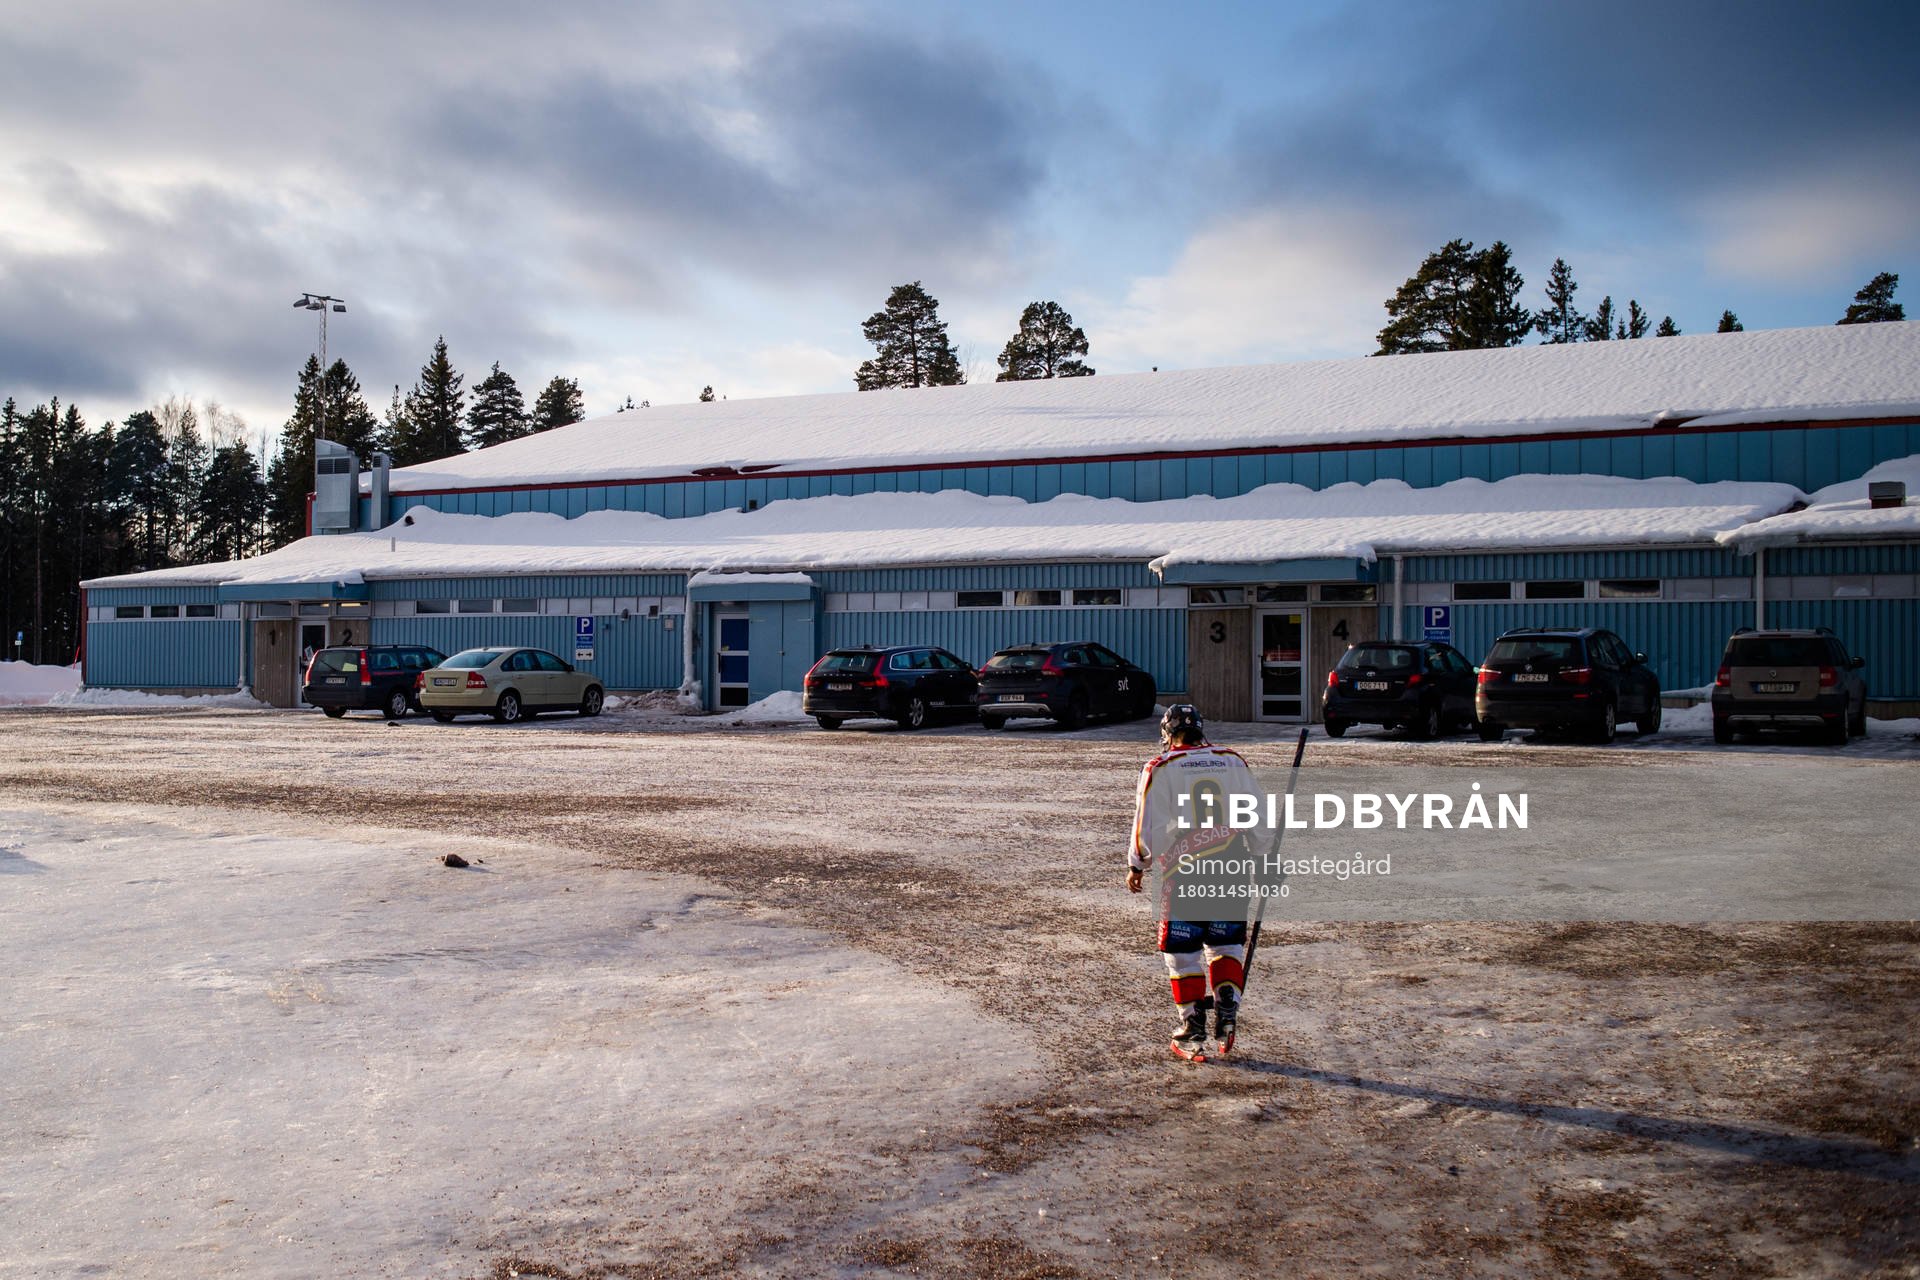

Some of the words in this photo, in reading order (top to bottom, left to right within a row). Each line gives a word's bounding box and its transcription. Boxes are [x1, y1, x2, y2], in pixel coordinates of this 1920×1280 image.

[581, 618, 590, 633] P
[1431, 608, 1445, 627] P
[269, 629, 276, 646] 1
[342, 629, 353, 645] 2
[1210, 621, 1226, 644] 3
[1332, 620, 1349, 641] 4
[1117, 676, 1129, 691] svt
[1193, 825, 1230, 848] SSAB
